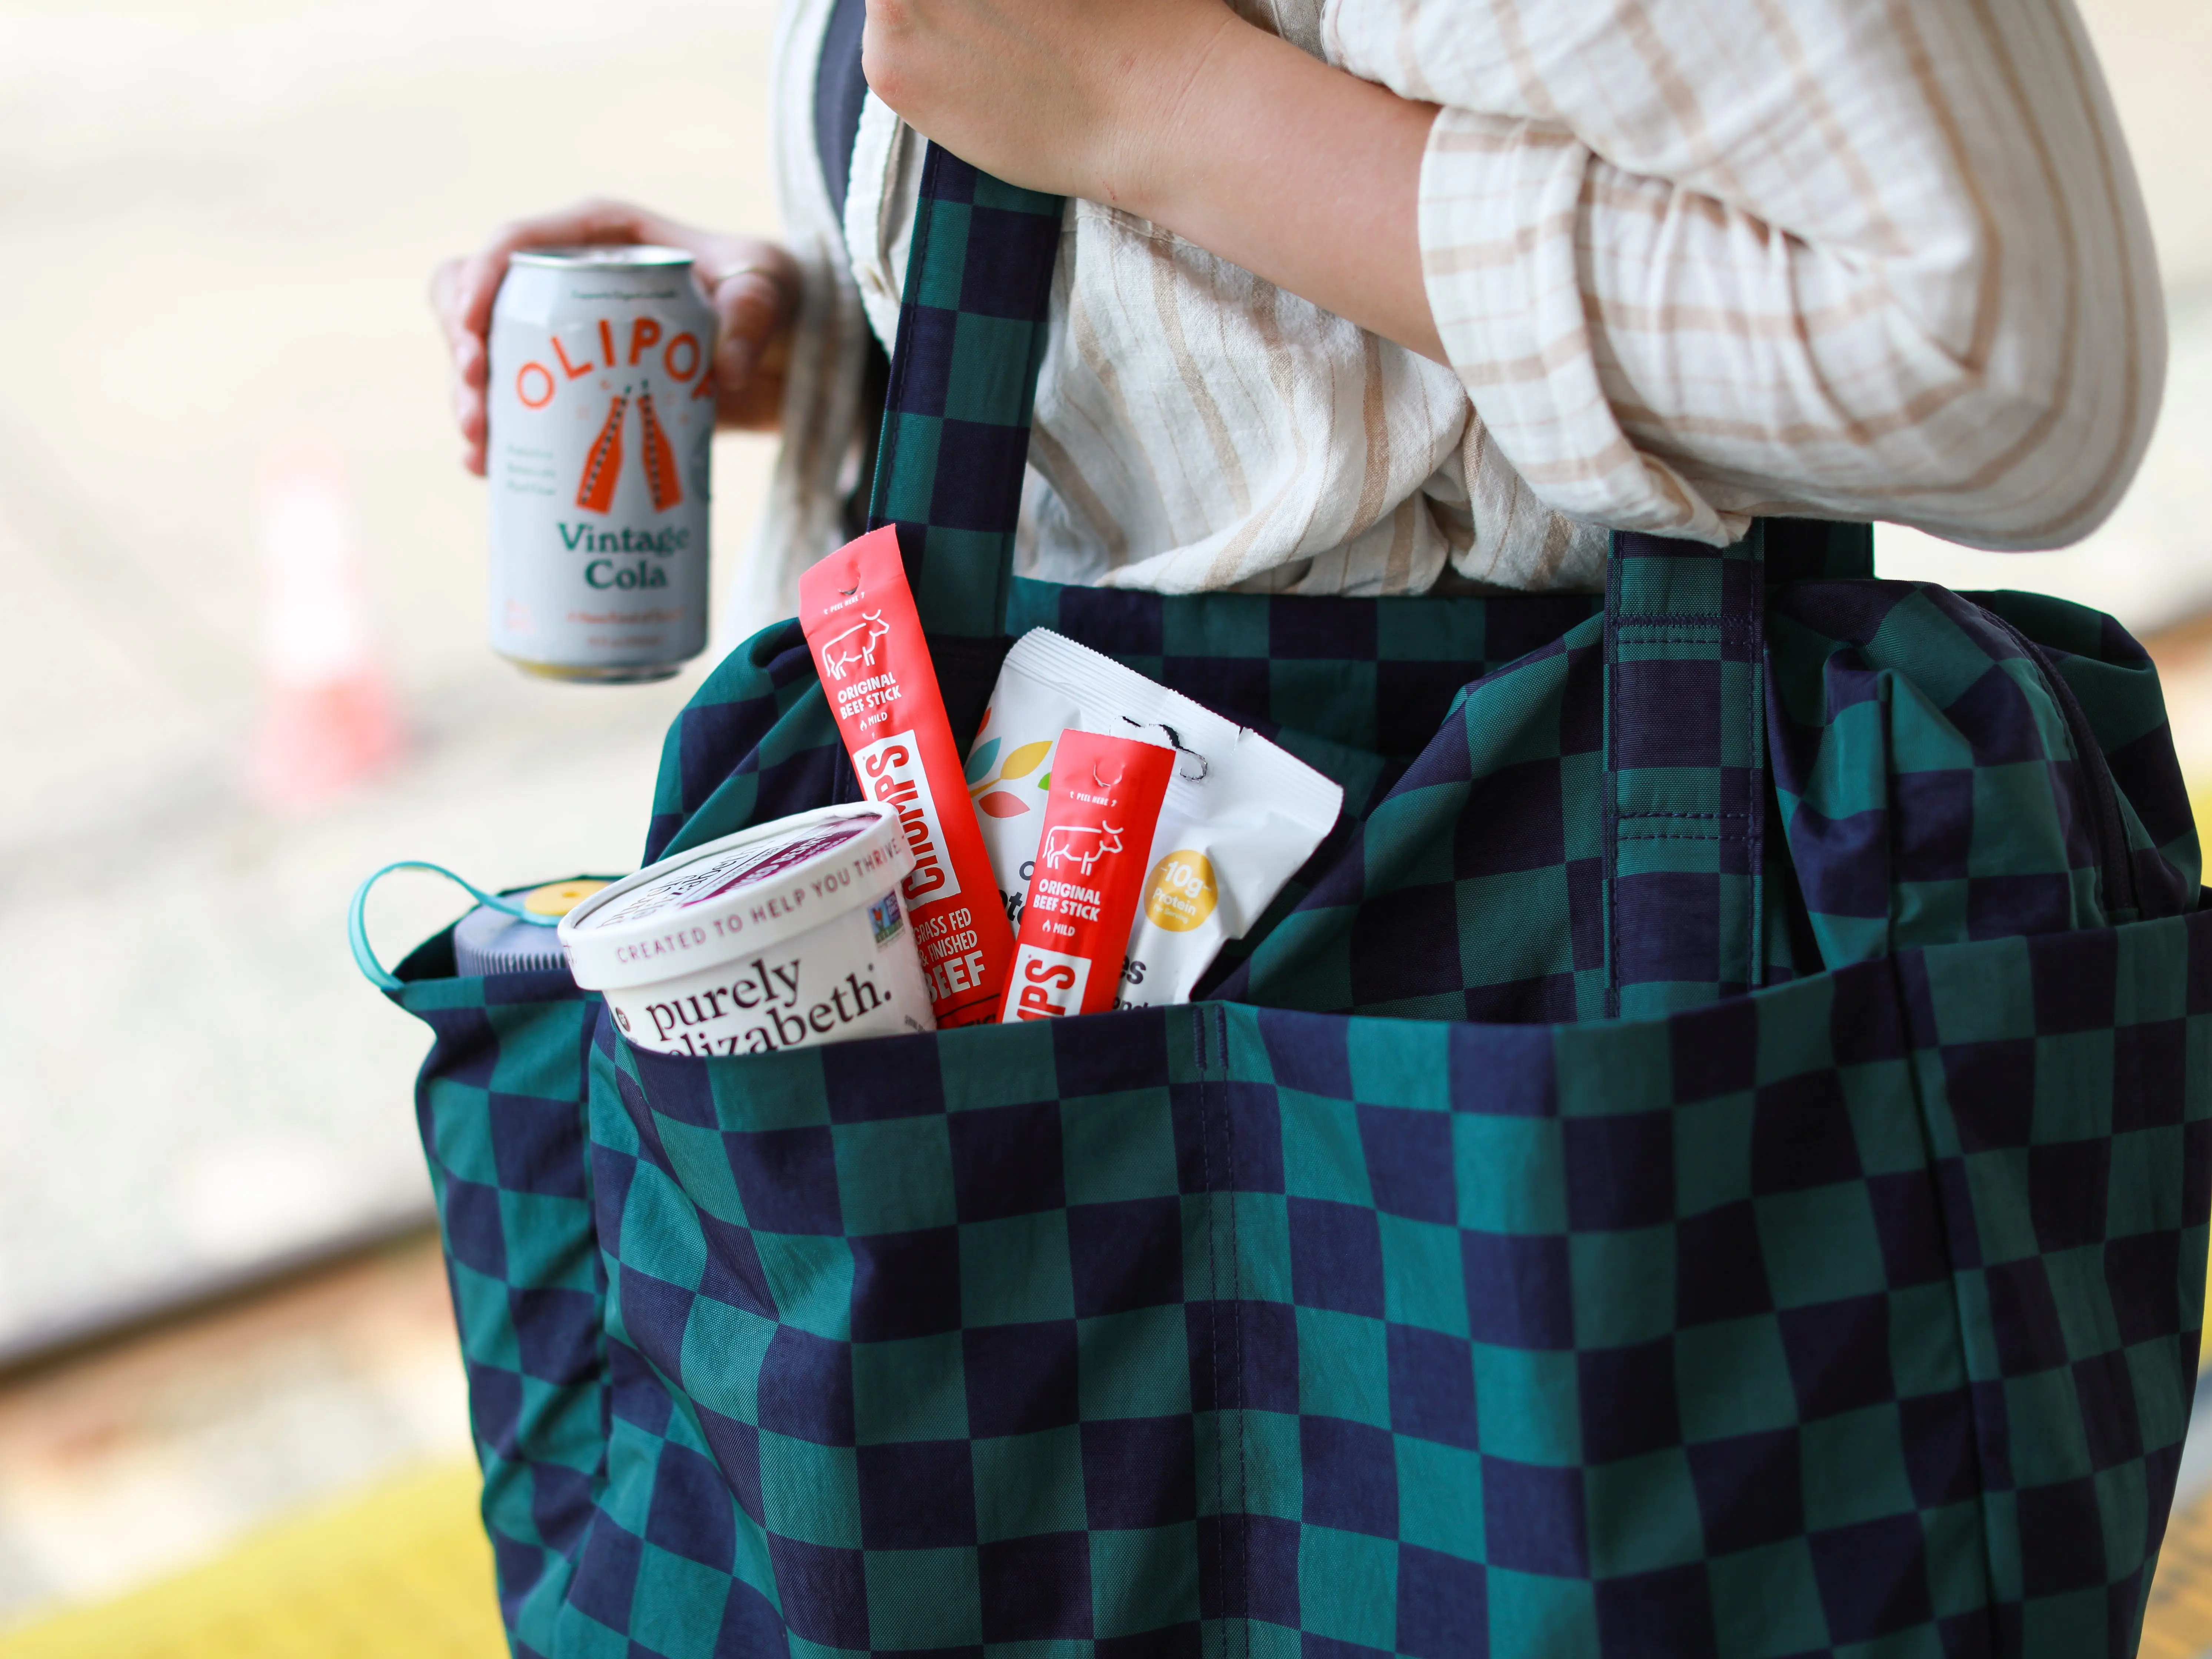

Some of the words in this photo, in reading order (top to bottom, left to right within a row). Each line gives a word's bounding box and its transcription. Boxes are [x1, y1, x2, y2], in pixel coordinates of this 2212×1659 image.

[557, 522, 690, 556] Vintage
[584, 560, 669, 591] Cola
[830, 602, 843, 613] PEEL
[845, 595, 859, 606] HERE
[838, 672, 896, 703] ORIGINAL
[840, 698, 864, 720] BEEF
[866, 685, 902, 708] STICK
[868, 712, 888, 726] MILD
[1076, 792, 1091, 802] PEEL
[1092, 795, 1109, 806] HERE
[617, 927, 706, 963] CREATED
[713, 914, 743, 936] TO
[750, 888, 805, 924] HELP
[811, 867, 851, 898] YOU
[853, 837, 902, 878] THRIVE
[1039, 878, 1101, 905] ORIGINAL
[1152, 887, 1196, 916] Protein
[1033, 894, 1059, 912] BEEF
[1060, 899, 1101, 922] STICK
[913, 916, 947, 945] GRASS
[948, 908, 971, 930] FED
[1053, 922, 1076, 937] MILD
[918, 949, 929, 967] &
[927, 930, 977, 962] FINISHED
[925, 950, 985, 1003] BEEF
[645, 958, 801, 1041] purely
[669, 972, 891, 1056] lizabeth.
